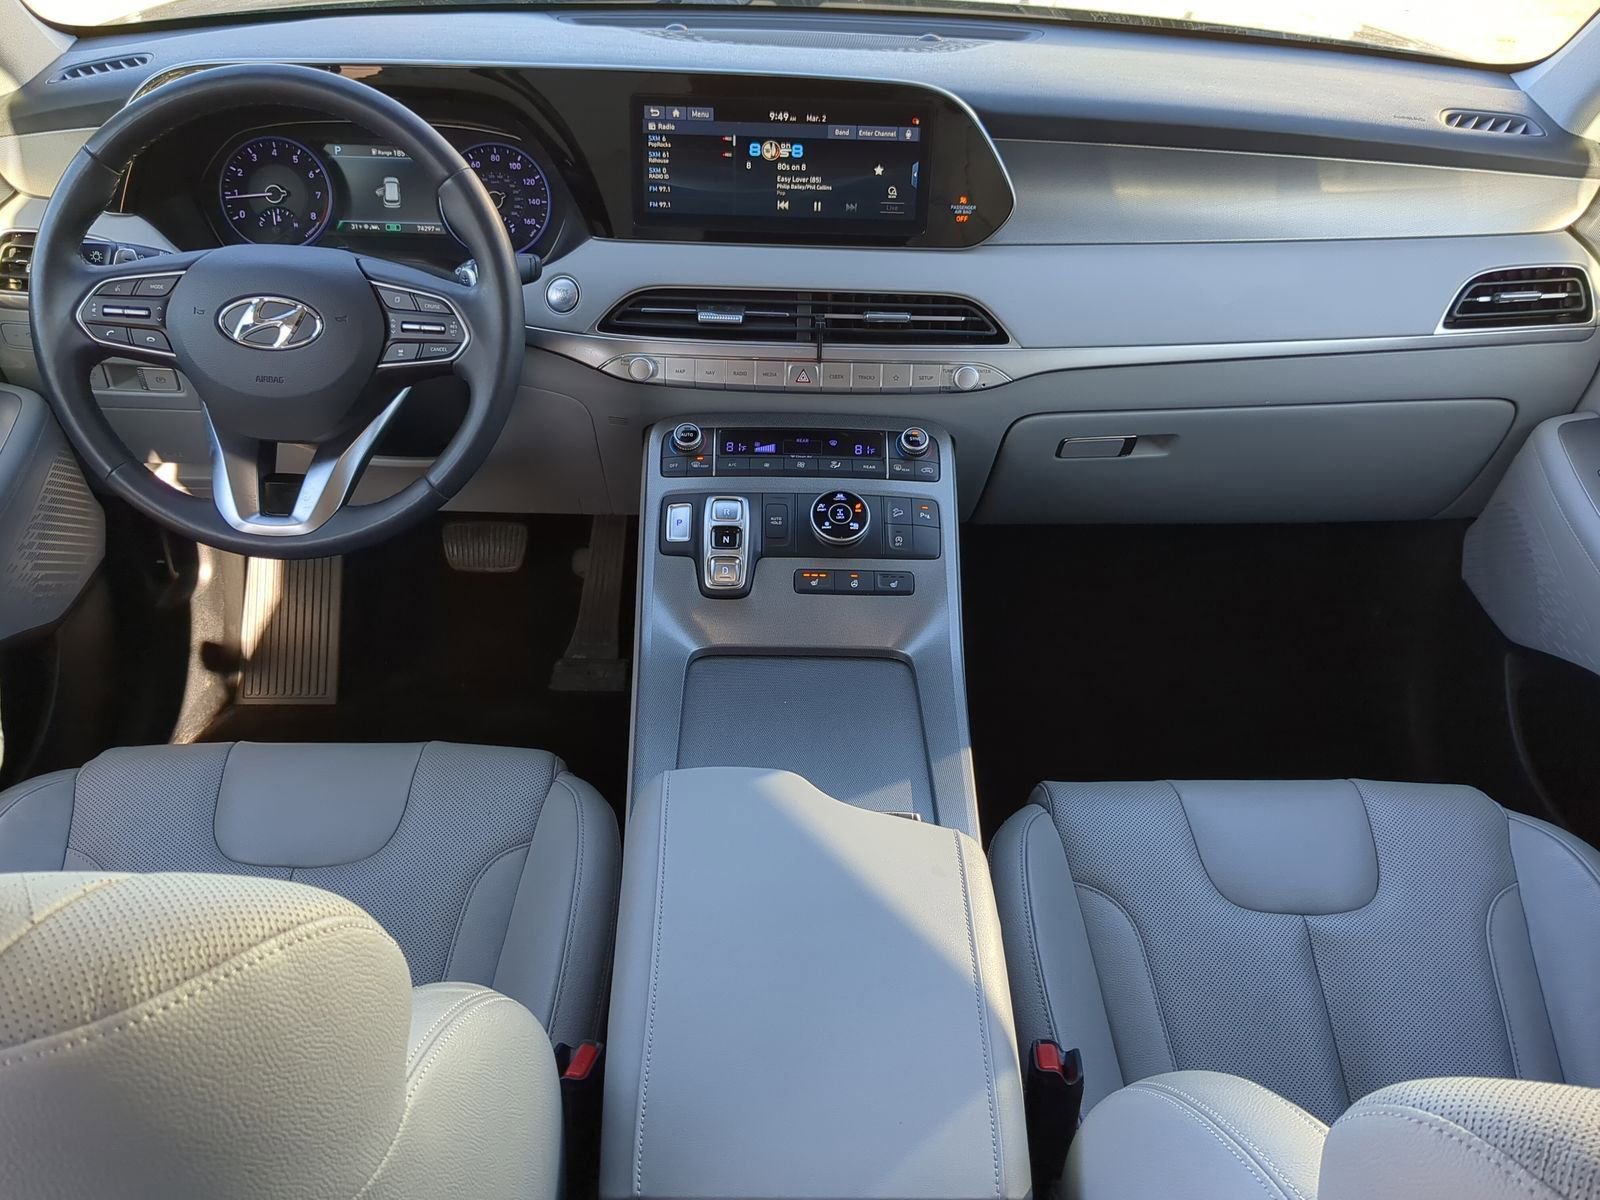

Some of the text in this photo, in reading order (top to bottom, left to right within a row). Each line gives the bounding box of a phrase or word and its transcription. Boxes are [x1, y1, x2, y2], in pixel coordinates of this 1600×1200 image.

[691, 110, 709, 118] Menu
[769, 112, 789, 121] 9:49
[806, 114, 820, 122] Mar.
[874, 130, 896, 138] Channel
[334, 146, 342, 155] P
[252, 154, 258, 162] 3
[292, 155, 298, 164] 5
[509, 162, 522, 170] 100
[746, 161, 752, 170] 8
[237, 168, 244, 177] 2
[308, 170, 314, 178] 6
[777, 176, 791, 184] Easy
[316, 191, 321, 199] 7
[239, 210, 246, 218] 0
[310, 212, 317, 220] 8
[255, 376, 284, 384] AIRBAG
[722, 566, 728, 574] D
